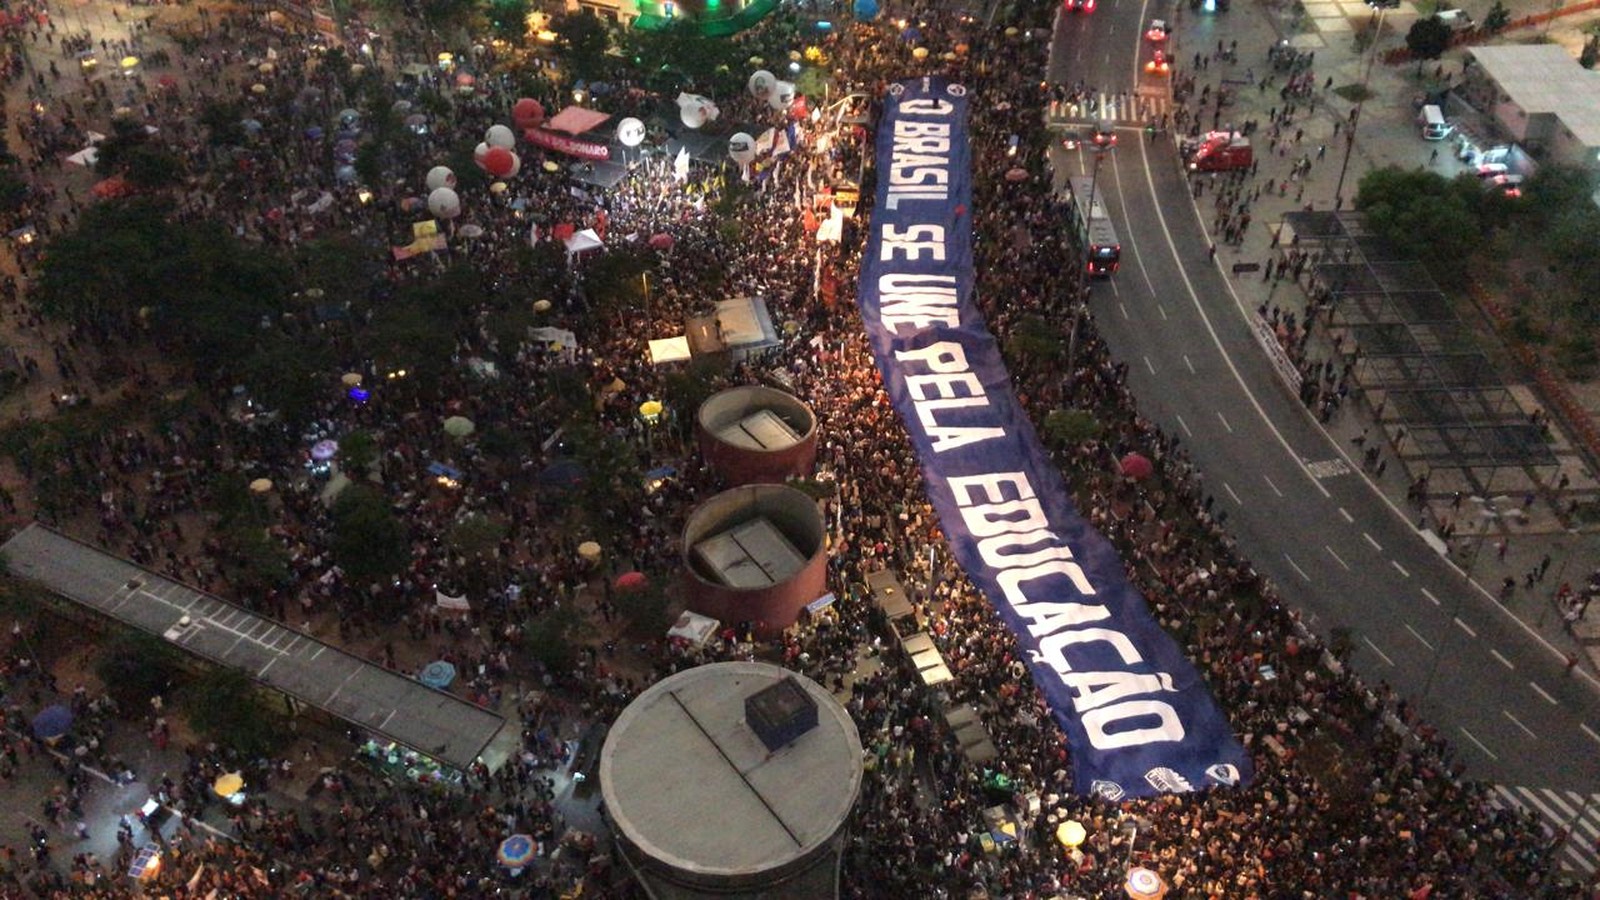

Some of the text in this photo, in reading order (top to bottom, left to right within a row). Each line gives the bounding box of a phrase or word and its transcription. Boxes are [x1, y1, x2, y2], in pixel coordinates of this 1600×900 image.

[900, 99, 953, 115] O
[886, 120, 950, 210] BRASIL
[881, 224, 946, 261] SE
[878, 273, 961, 336] UNE
[894, 341, 1006, 453] PELA
[947, 471, 1185, 750] EDUCAÇÃO
